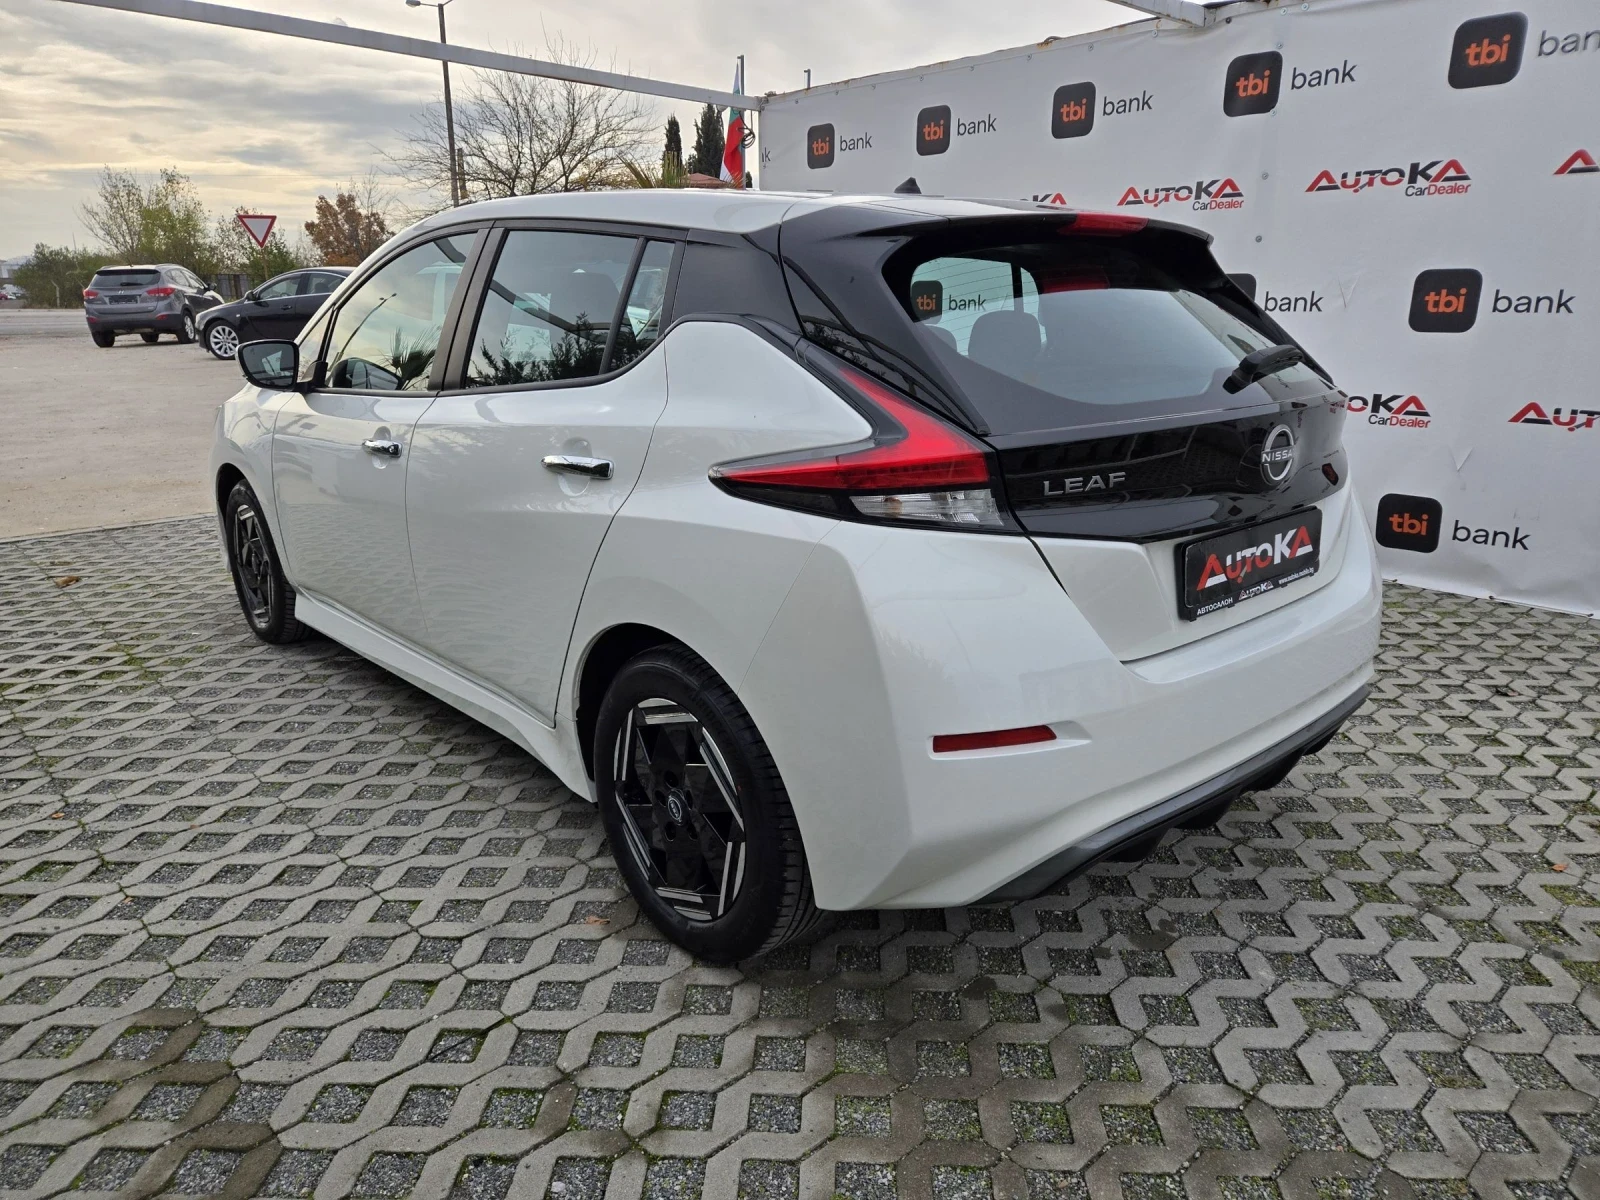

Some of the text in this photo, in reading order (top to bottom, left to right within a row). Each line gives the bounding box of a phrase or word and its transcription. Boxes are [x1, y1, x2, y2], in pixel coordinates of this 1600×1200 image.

[1465, 30, 1600, 66] tbi ban
[1235, 60, 1357, 97] tbi bank
[1060, 90, 1153, 122] tbi bank
[922, 114, 997, 141] tbi bank
[812, 132, 873, 155] tbi bank
[916, 294, 987, 312] tbi bank
[1263, 291, 1324, 313] bank
[1425, 288, 1576, 314] tbi bank
[1262, 449, 1293, 462] NISSA
[1043, 471, 1126, 496] LEAF
[1389, 513, 1531, 550] tbi bank
